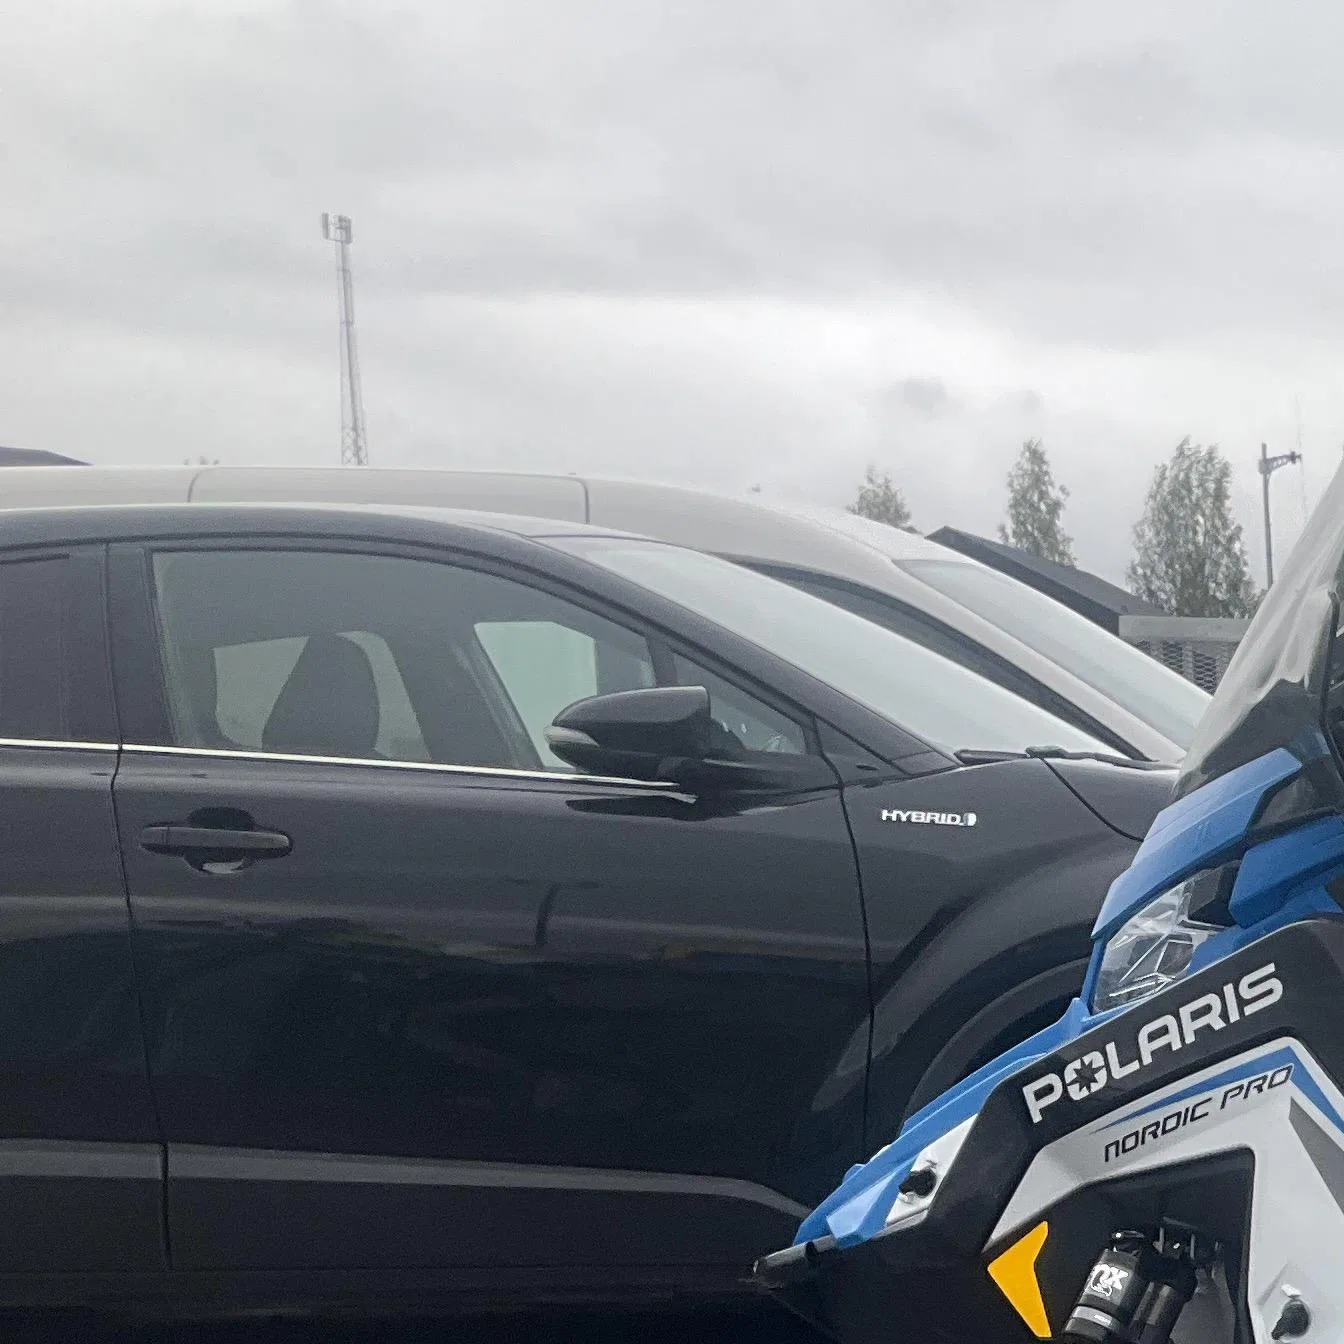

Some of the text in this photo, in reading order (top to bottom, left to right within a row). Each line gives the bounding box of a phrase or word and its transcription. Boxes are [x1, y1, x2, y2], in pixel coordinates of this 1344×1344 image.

[881, 809, 961, 826] HYBRID
[1022, 962, 1284, 1124] POLARIS
[1104, 1065, 1293, 1162] NORDIC PRO
